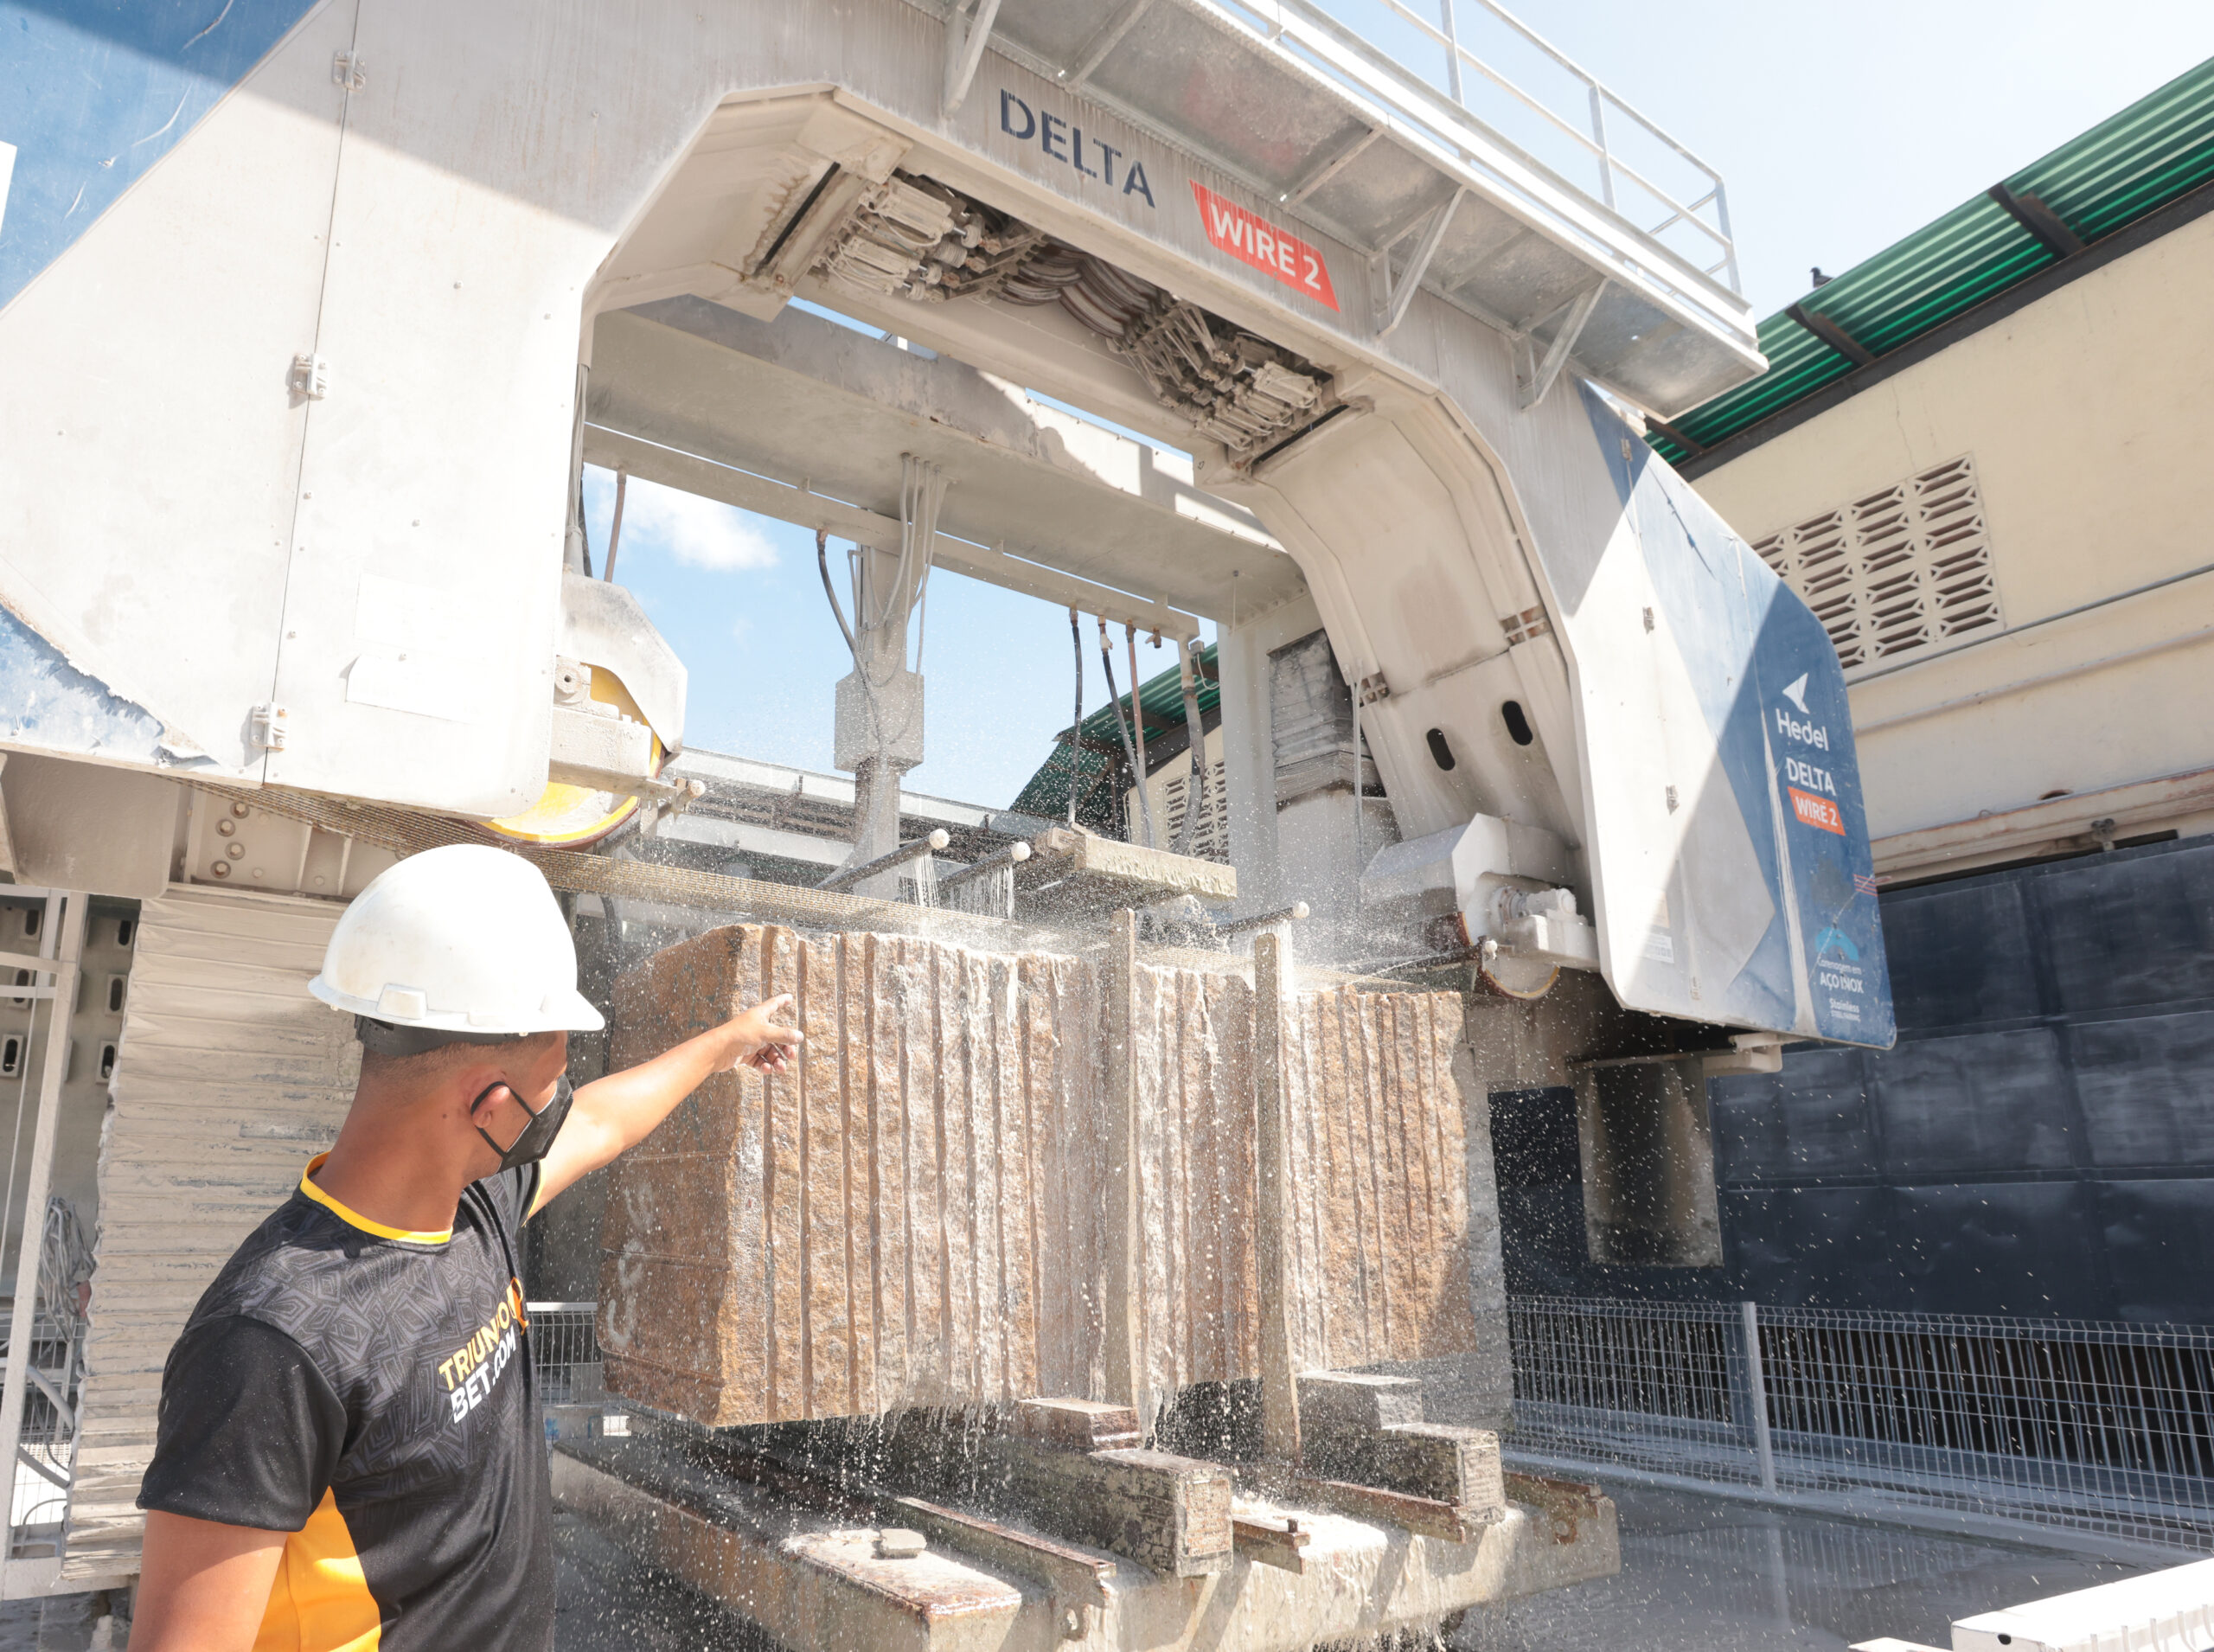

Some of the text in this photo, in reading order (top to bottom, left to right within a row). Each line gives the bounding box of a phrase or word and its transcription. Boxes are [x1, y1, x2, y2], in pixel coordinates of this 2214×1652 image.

[1001, 88, 1321, 291] DELTA WIRE 2
[1776, 708, 1829, 752] Hedel
[1786, 757, 1837, 797] DELTA
[1795, 795, 1839, 827] WIRE 2
[1820, 971, 1865, 994] AÇO INOX
